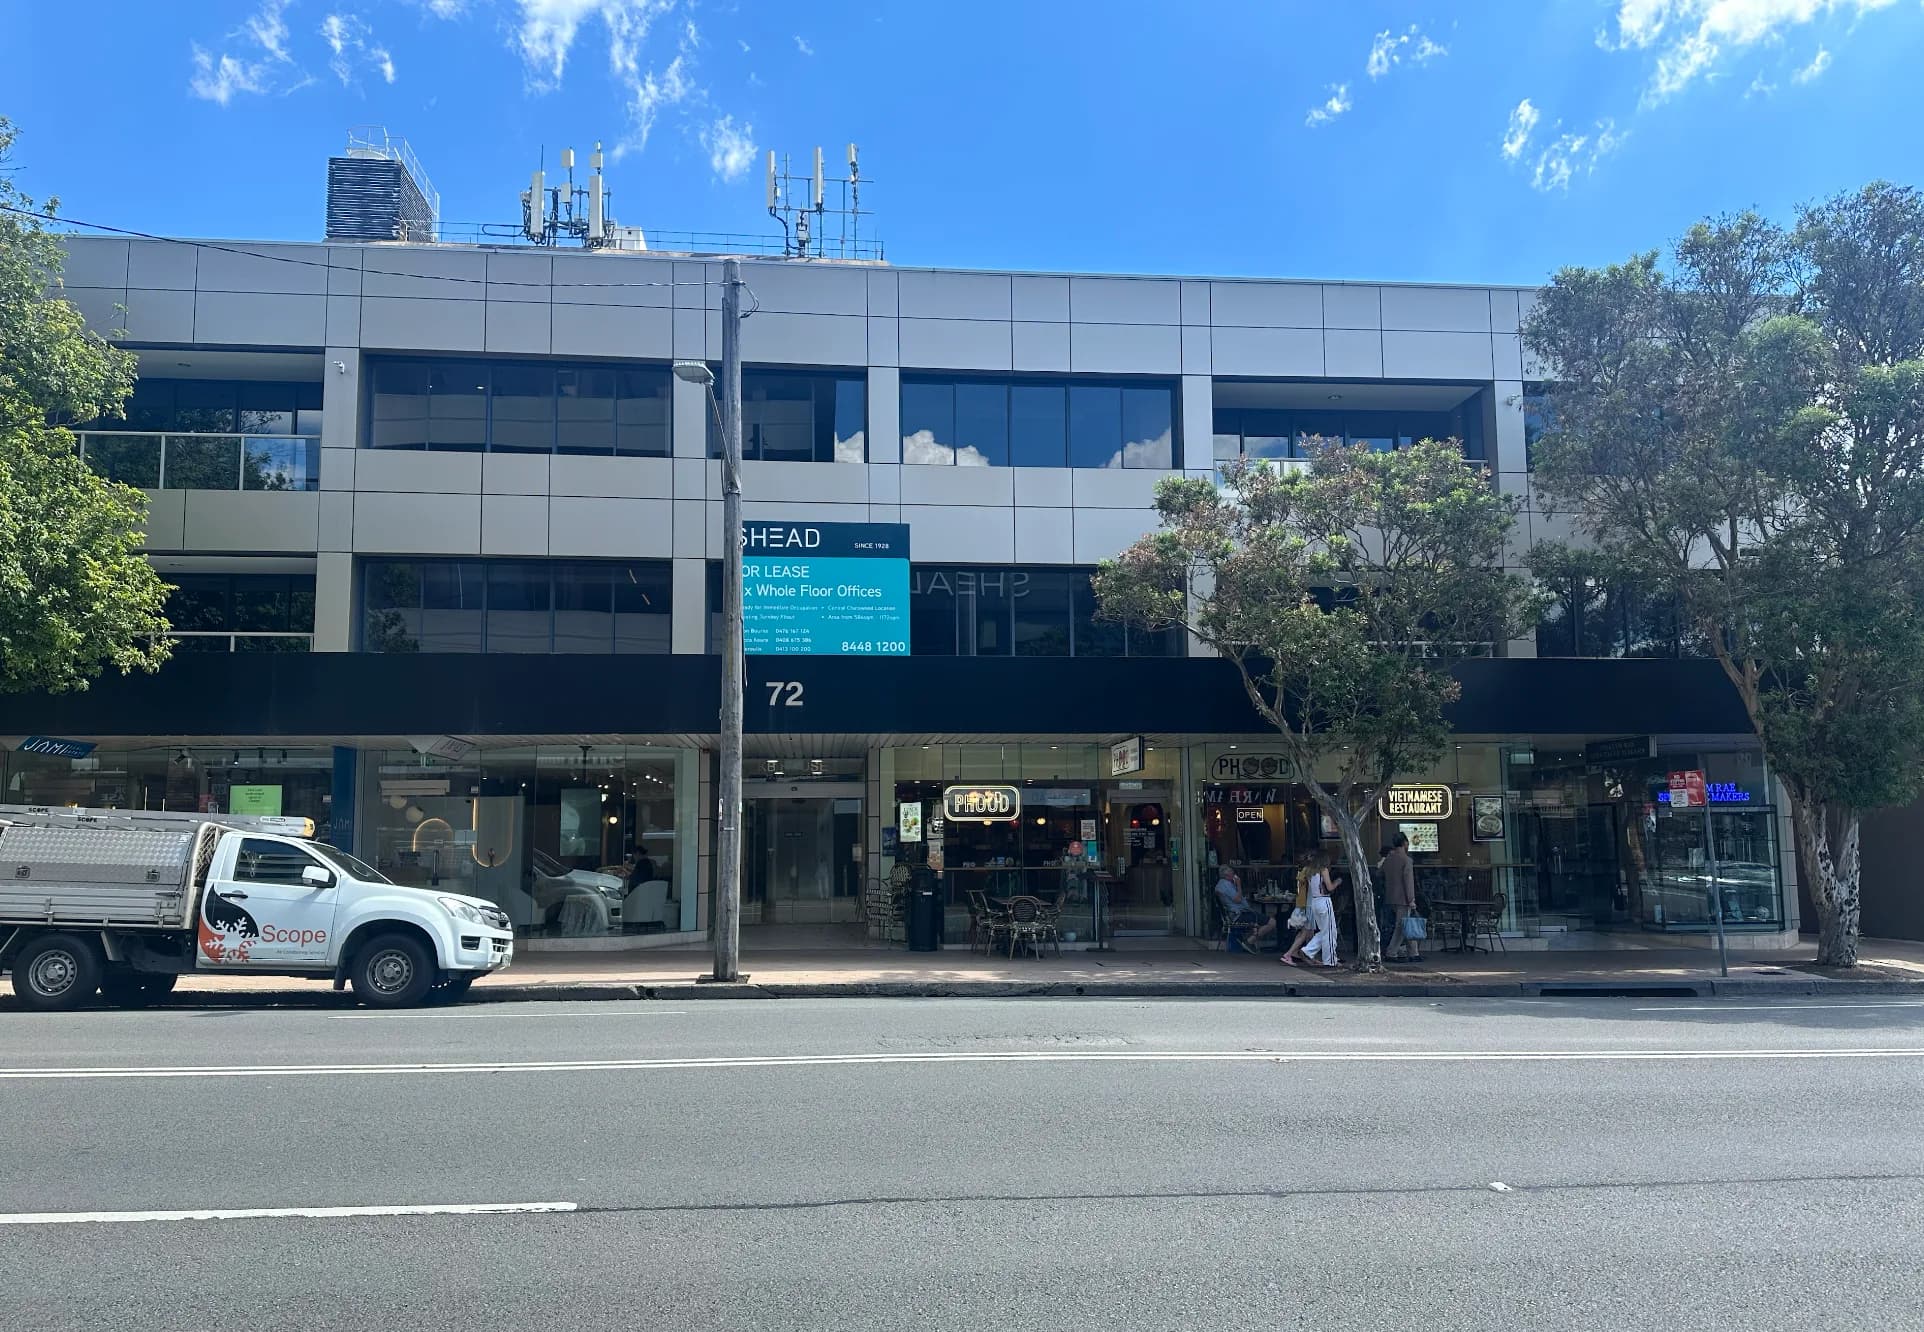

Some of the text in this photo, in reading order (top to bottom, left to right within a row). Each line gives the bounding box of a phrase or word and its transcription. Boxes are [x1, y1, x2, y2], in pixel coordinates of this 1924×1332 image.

[764, 565, 810, 578] LEASE
[756, 584, 796, 597] Whole
[800, 584, 833, 597] Floor
[837, 585, 882, 597] Offices
[841, 641, 906, 652] 8448 1200
[765, 681, 804, 706] 72
[1715, 783, 1736, 792] RAE
[1388, 790, 1442, 802] VIETNAMESE
[1389, 802, 1442, 813] RESTAURANT
[1238, 811, 1262, 819] OPEN
[261, 924, 327, 948] Scope
